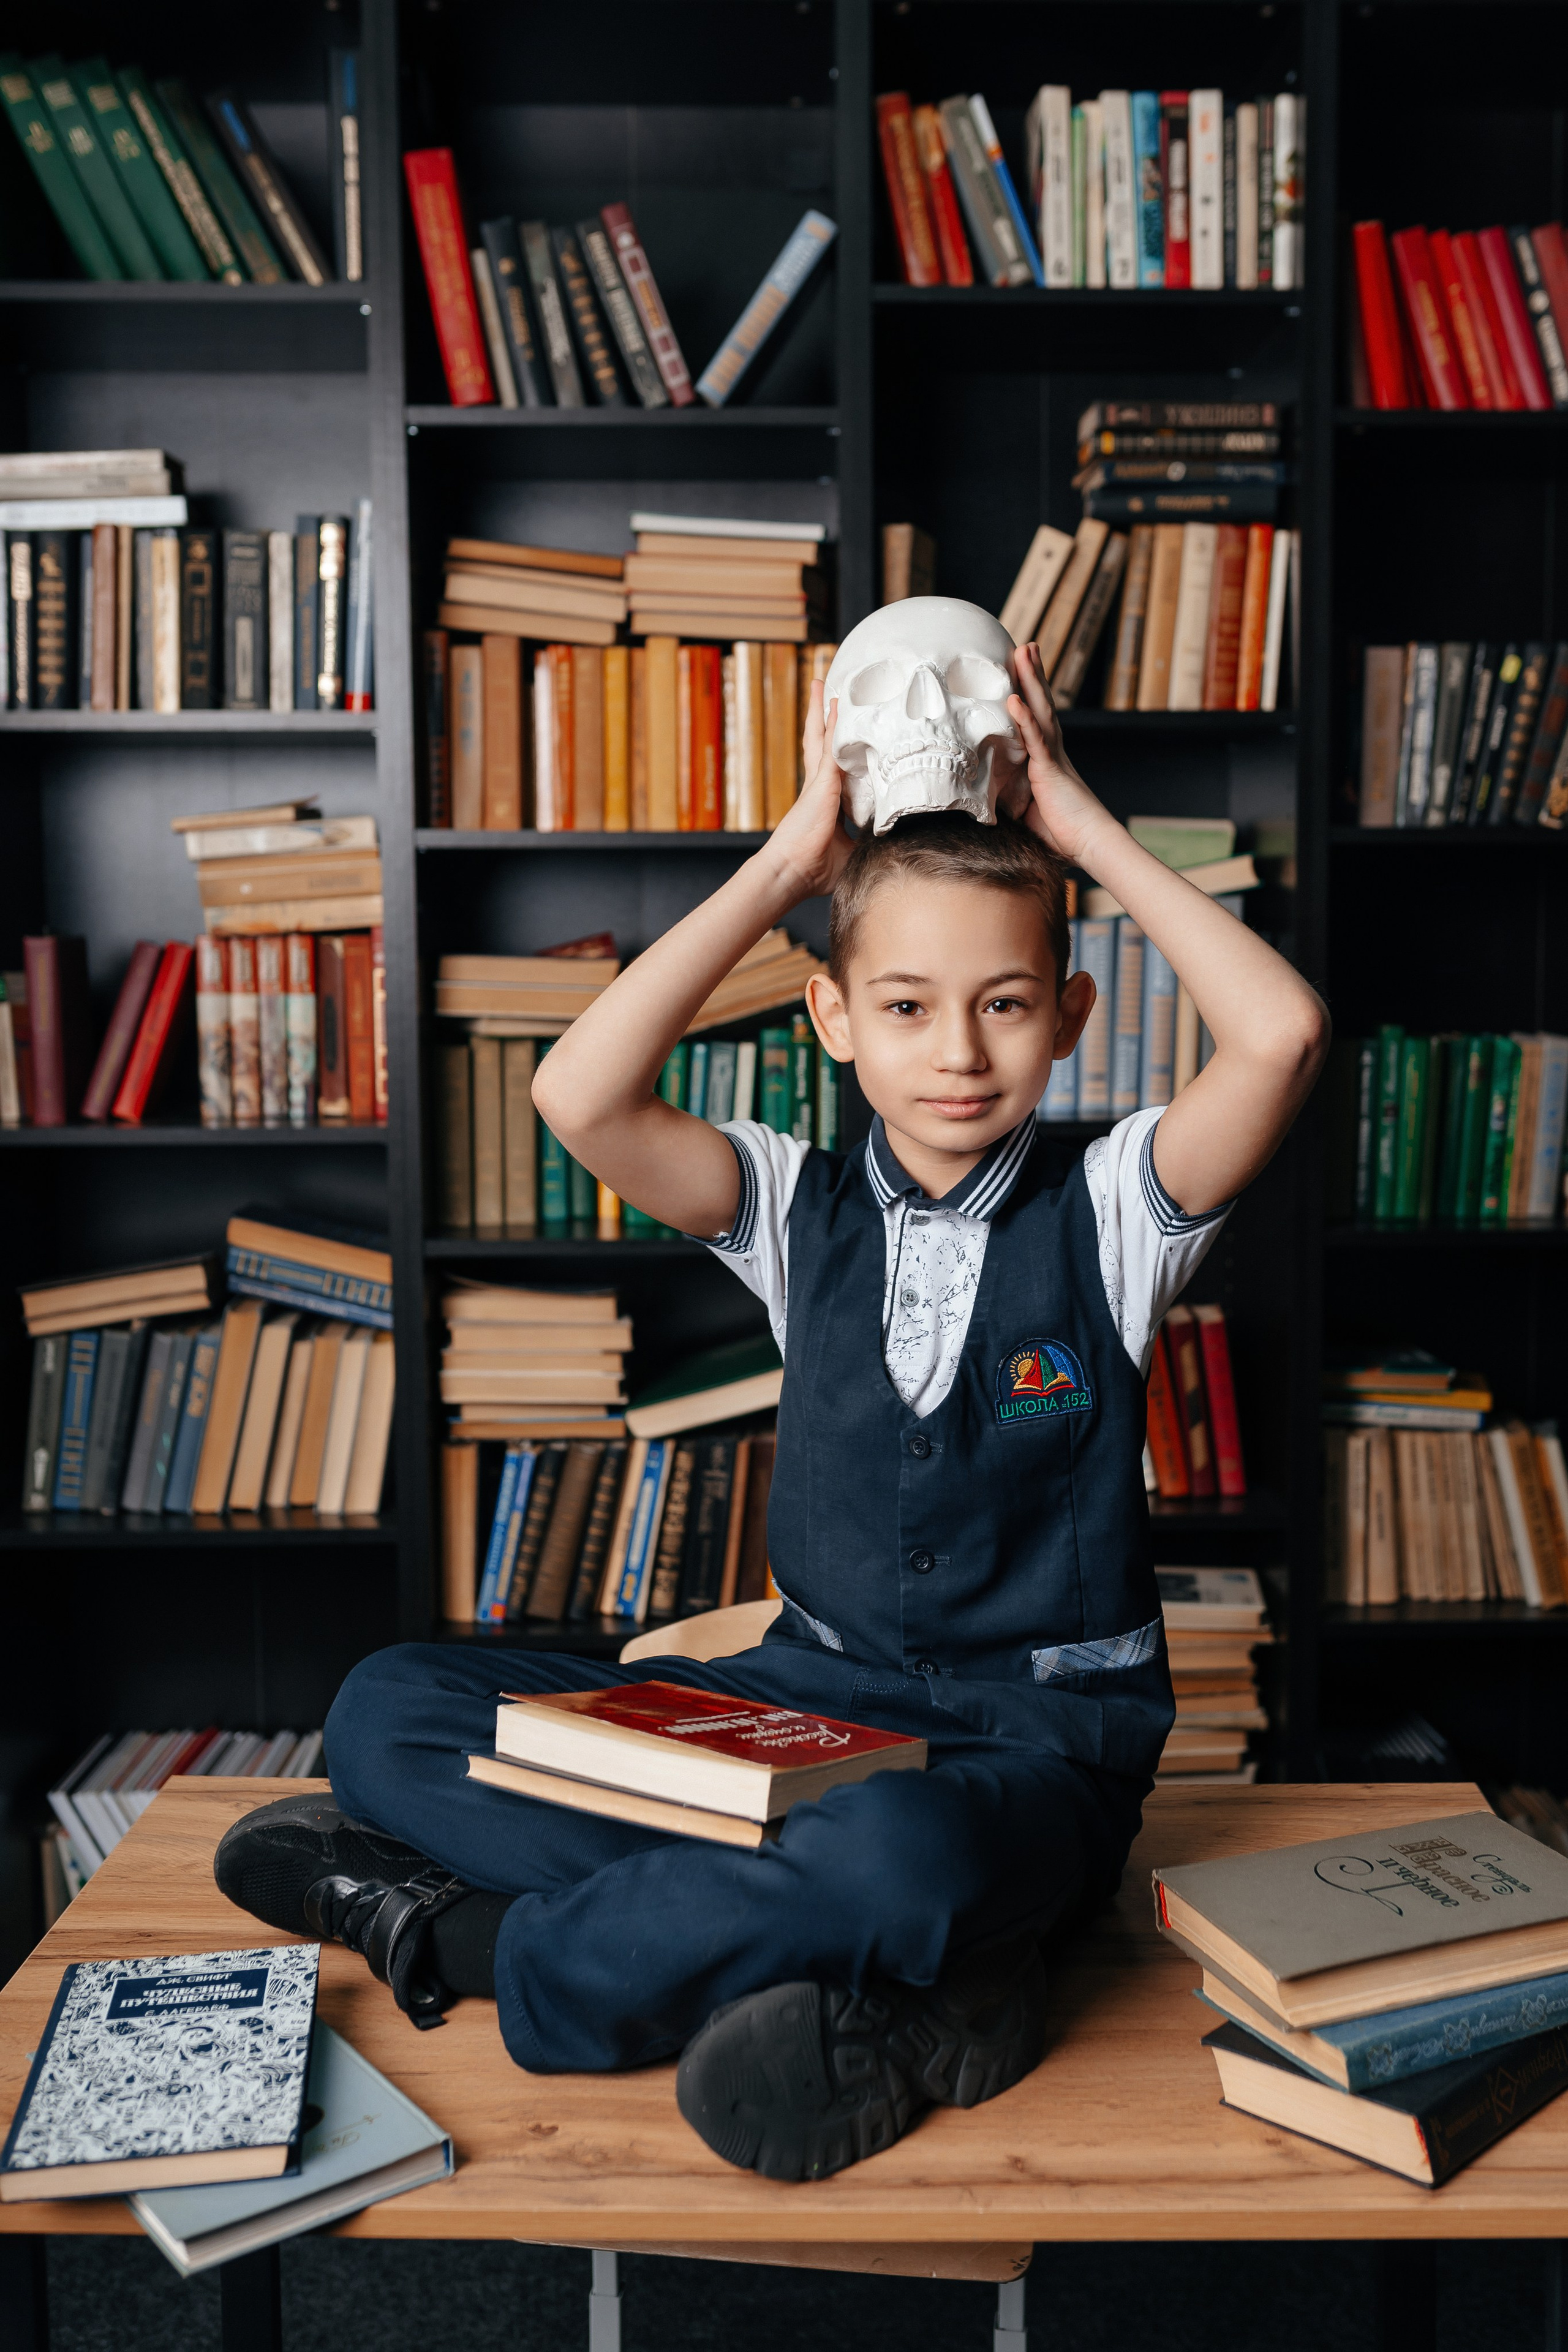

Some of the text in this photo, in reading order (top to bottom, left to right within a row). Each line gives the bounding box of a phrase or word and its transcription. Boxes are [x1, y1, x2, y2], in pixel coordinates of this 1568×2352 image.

[1000, 1397, 1059, 1419] ШКОЛА
[1389, 1835, 1490, 1902] Красное
[186, 1972, 233, 1983] СВИФТ
[119, 1988, 258, 2008] ПУТЕШЕСТВИЯ
[143, 1982, 241, 1998] ЧУДЕСНЫЕ
[159, 2003, 230, 2016] ЛАГЕРЛЁФ
